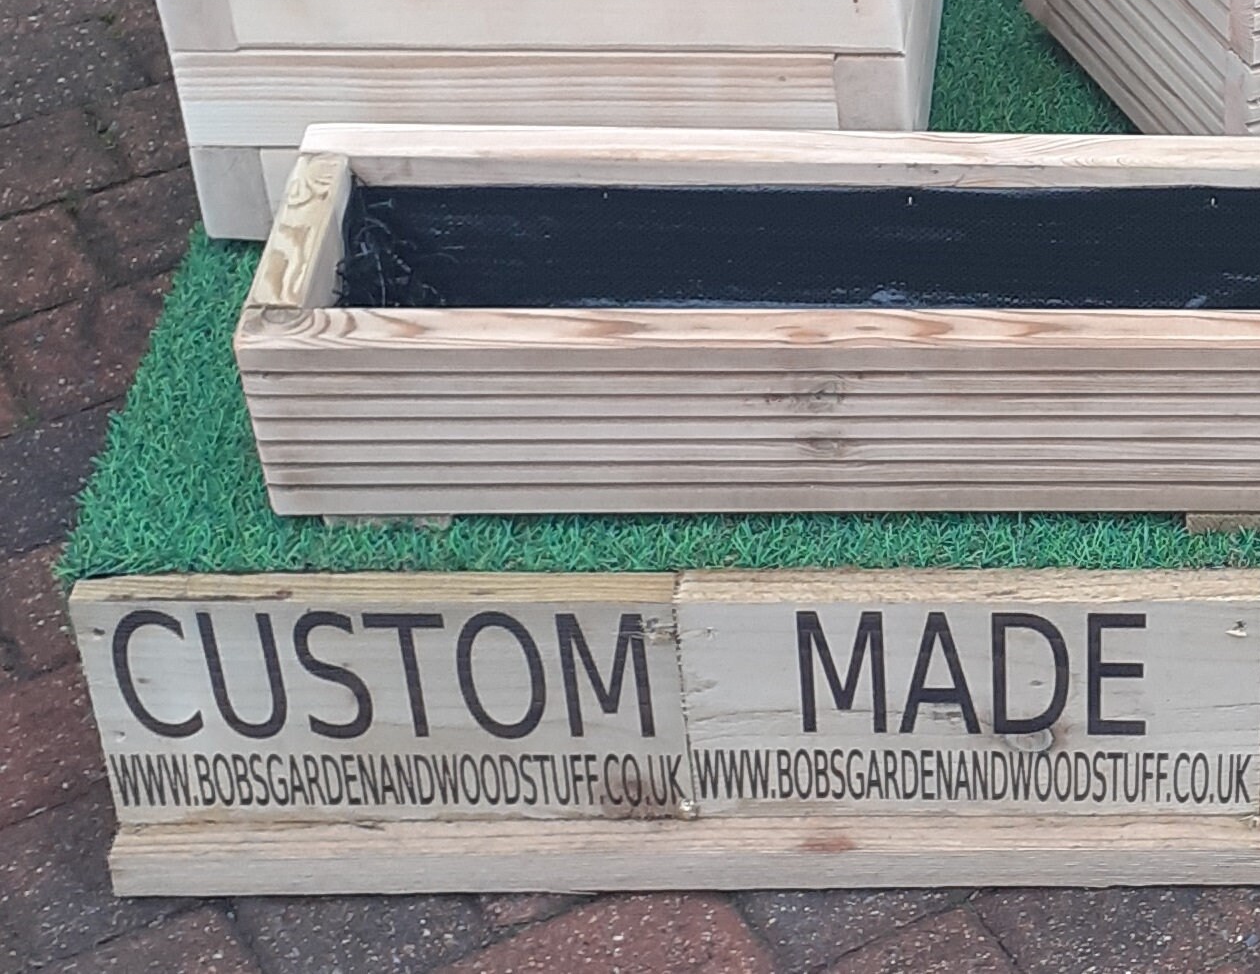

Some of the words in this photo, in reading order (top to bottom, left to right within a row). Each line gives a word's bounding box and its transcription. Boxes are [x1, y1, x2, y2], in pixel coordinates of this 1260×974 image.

[112, 609, 656, 739] CUSTOM
[796, 610, 1146, 735] MADE
[110, 753, 684, 807] WWW.BOBSGARDENANDWOODSTUFF.CO.UK
[697, 748, 1252, 804] WWW.BOBSGARDENANDWOODSTUFF.CO.UK
